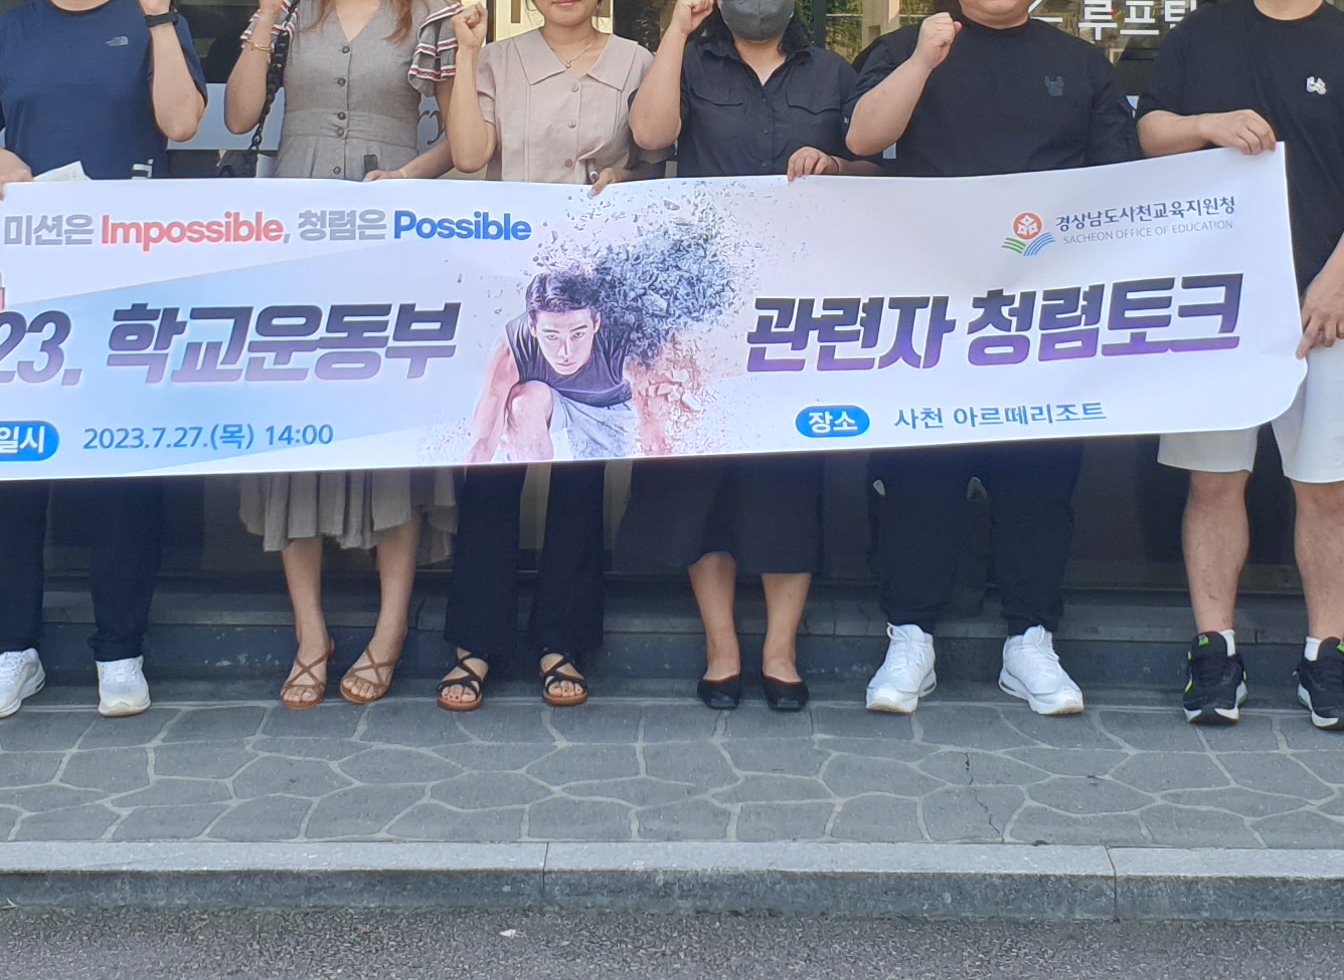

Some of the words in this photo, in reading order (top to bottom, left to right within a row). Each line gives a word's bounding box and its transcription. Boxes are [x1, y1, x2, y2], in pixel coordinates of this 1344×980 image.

[3, 214, 94, 246] 미션은
[101, 212, 291, 251] Impossible,
[298, 210, 387, 242] 청렴은
[393, 210, 532, 241] Possible
[1056, 195, 1236, 232] 경상남도사천교육지원청
[1063, 231, 1114, 245] SACHEON
[1115, 227, 1152, 239] OFFICE
[1154, 225, 1168, 236] OF
[1171, 219, 1234, 234] EDUCATION
[746, 295, 957, 372] 관련자
[966, 273, 1245, 366] 청렴토크
[106, 302, 461, 384] 학교운동부
[807, 409, 859, 433] 장소
[894, 407, 944, 430] 사천
[953, 401, 1107, 428] 아르떼리조트
[83, 422, 255, 451] 2023.7.27.(목)
[264, 425, 334, 447] 14:00
